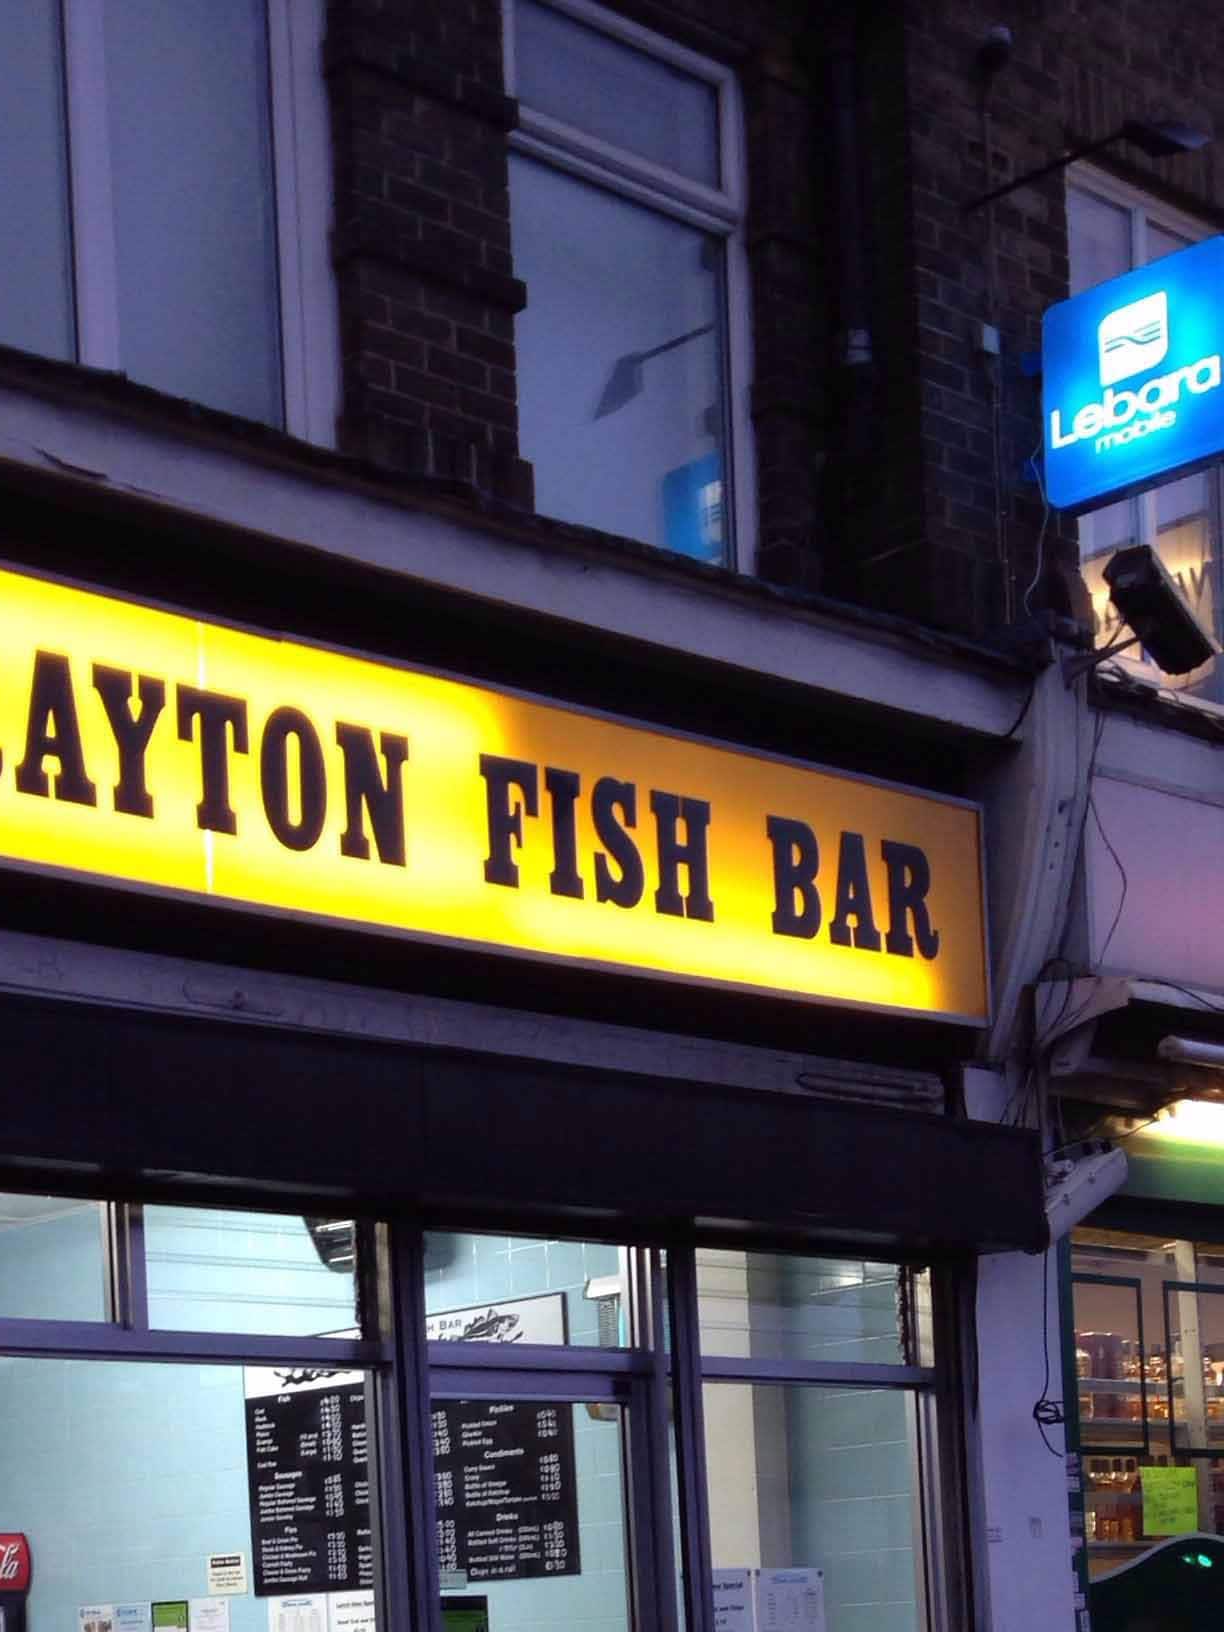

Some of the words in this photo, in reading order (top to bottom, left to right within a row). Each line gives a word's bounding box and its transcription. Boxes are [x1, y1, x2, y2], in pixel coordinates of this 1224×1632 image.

[1050, 354, 1221, 449] Lebara
[1095, 410, 1177, 454] mobile
[480, 754, 714, 923] FISH
[766, 815, 940, 960] BAR
[440, 1319, 462, 1329] BAR
